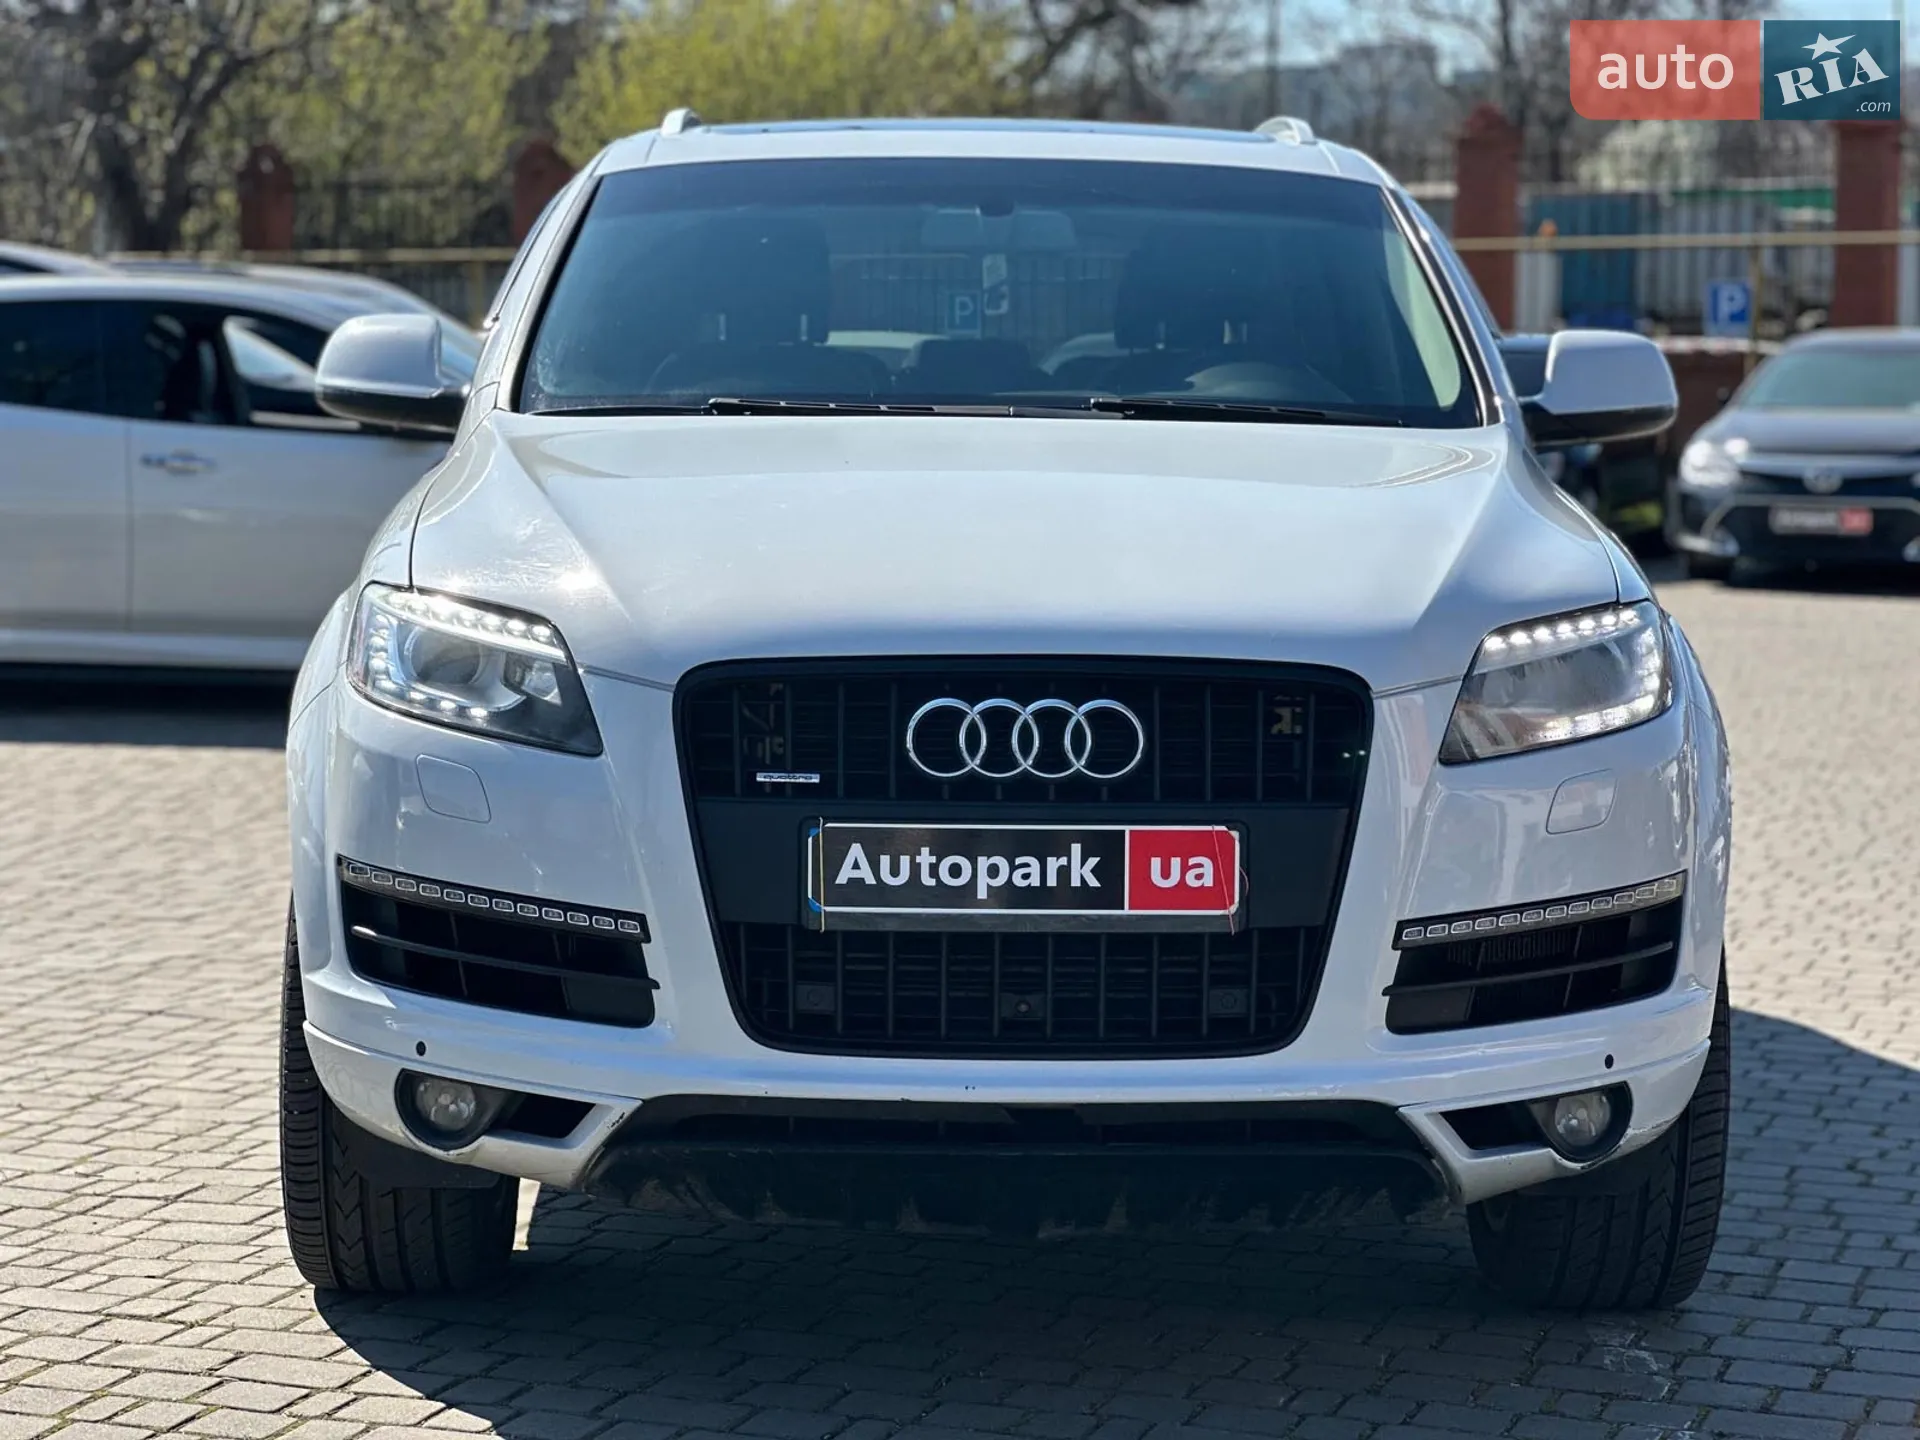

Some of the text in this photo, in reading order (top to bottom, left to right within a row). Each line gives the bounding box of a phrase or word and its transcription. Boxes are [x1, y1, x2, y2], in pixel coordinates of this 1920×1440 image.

[1718, 285, 1748, 322] P
[834, 843, 1215, 900] Autopark ua
